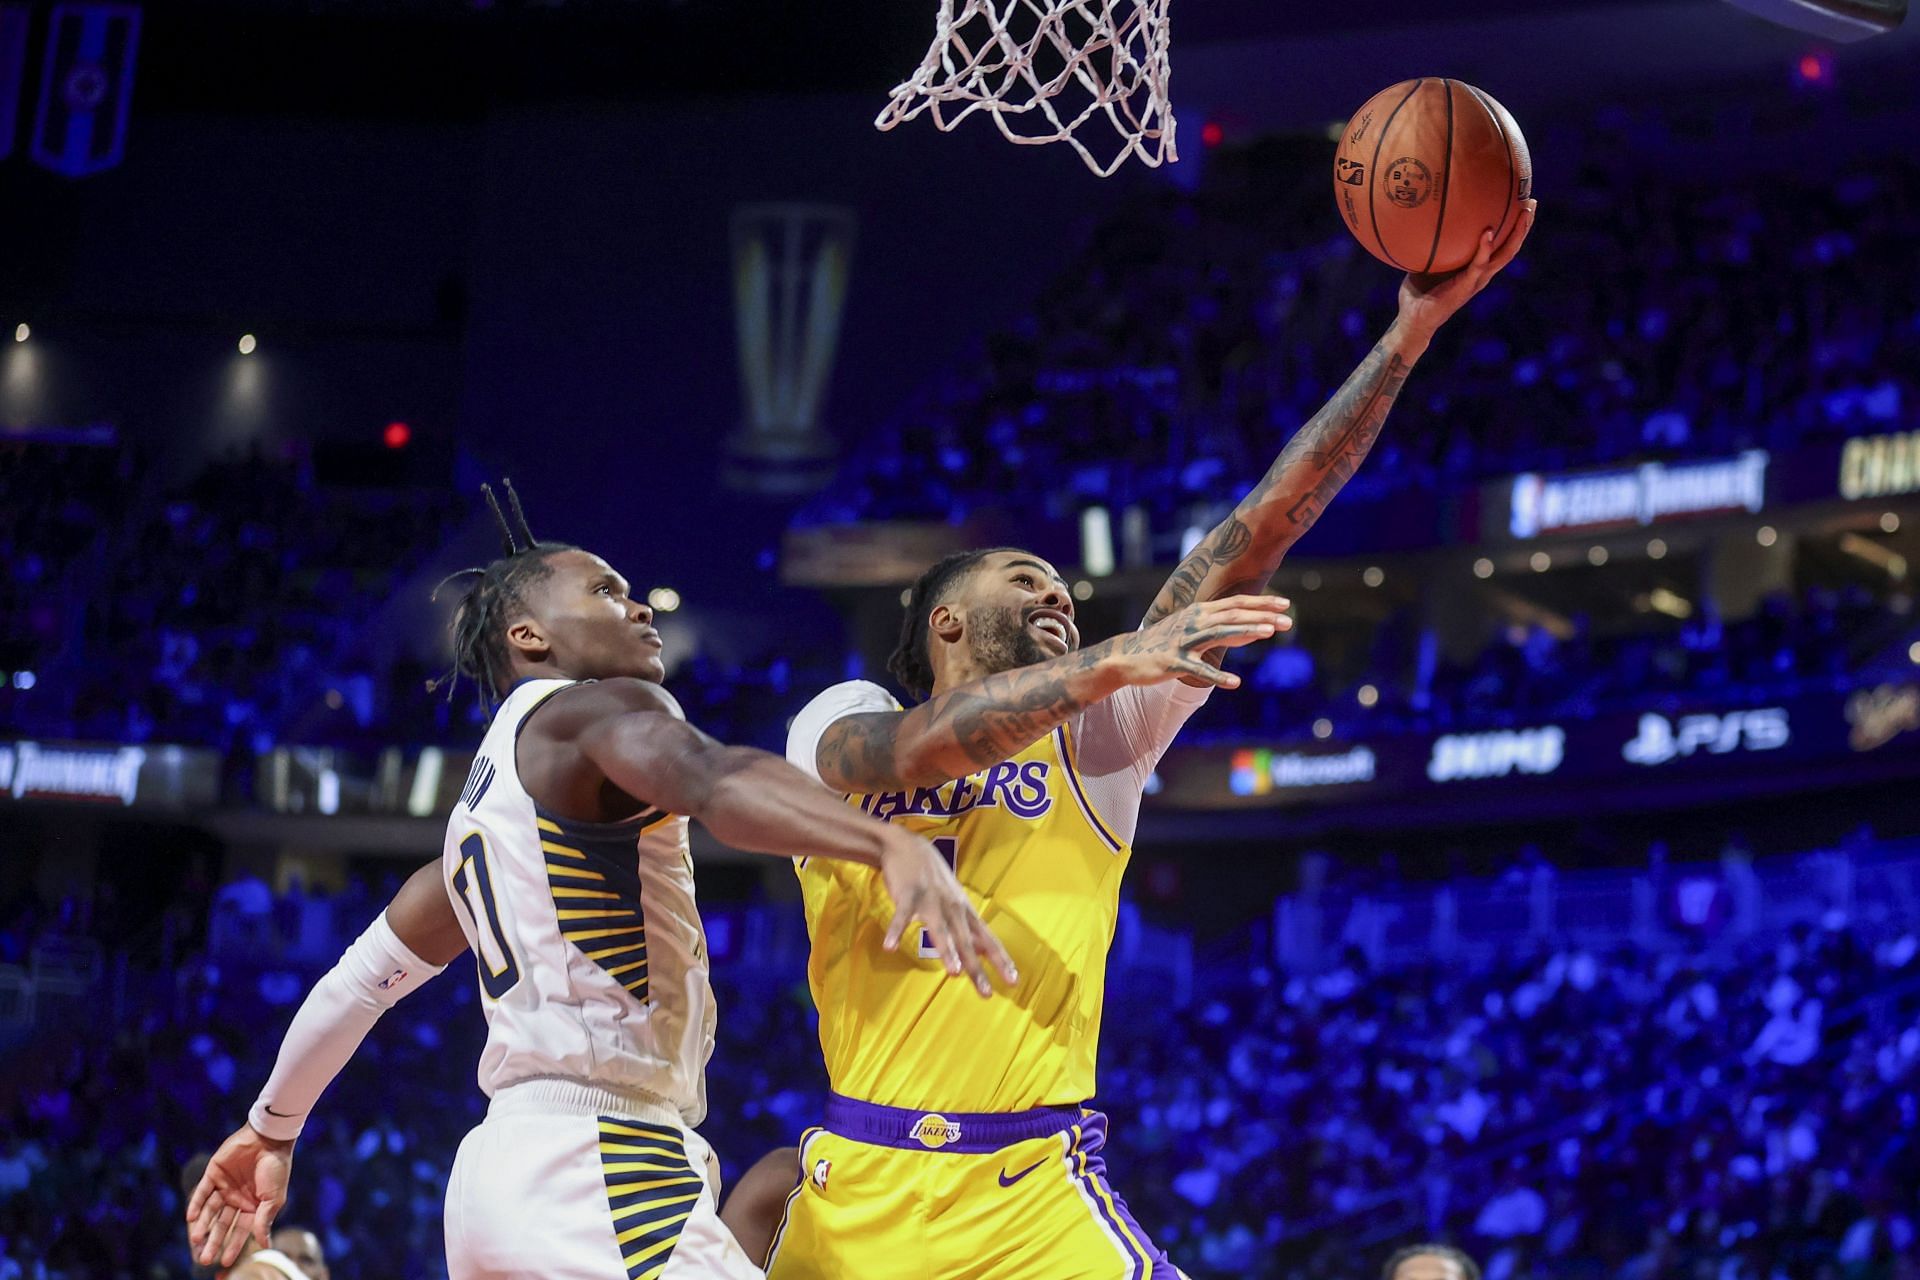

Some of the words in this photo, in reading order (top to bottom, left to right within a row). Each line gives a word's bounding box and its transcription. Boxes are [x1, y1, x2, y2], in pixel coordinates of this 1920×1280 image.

[1677, 707, 1789, 755] PS5
[450, 829, 521, 1003] 0
[913, 1121, 961, 1142] LAKERS
